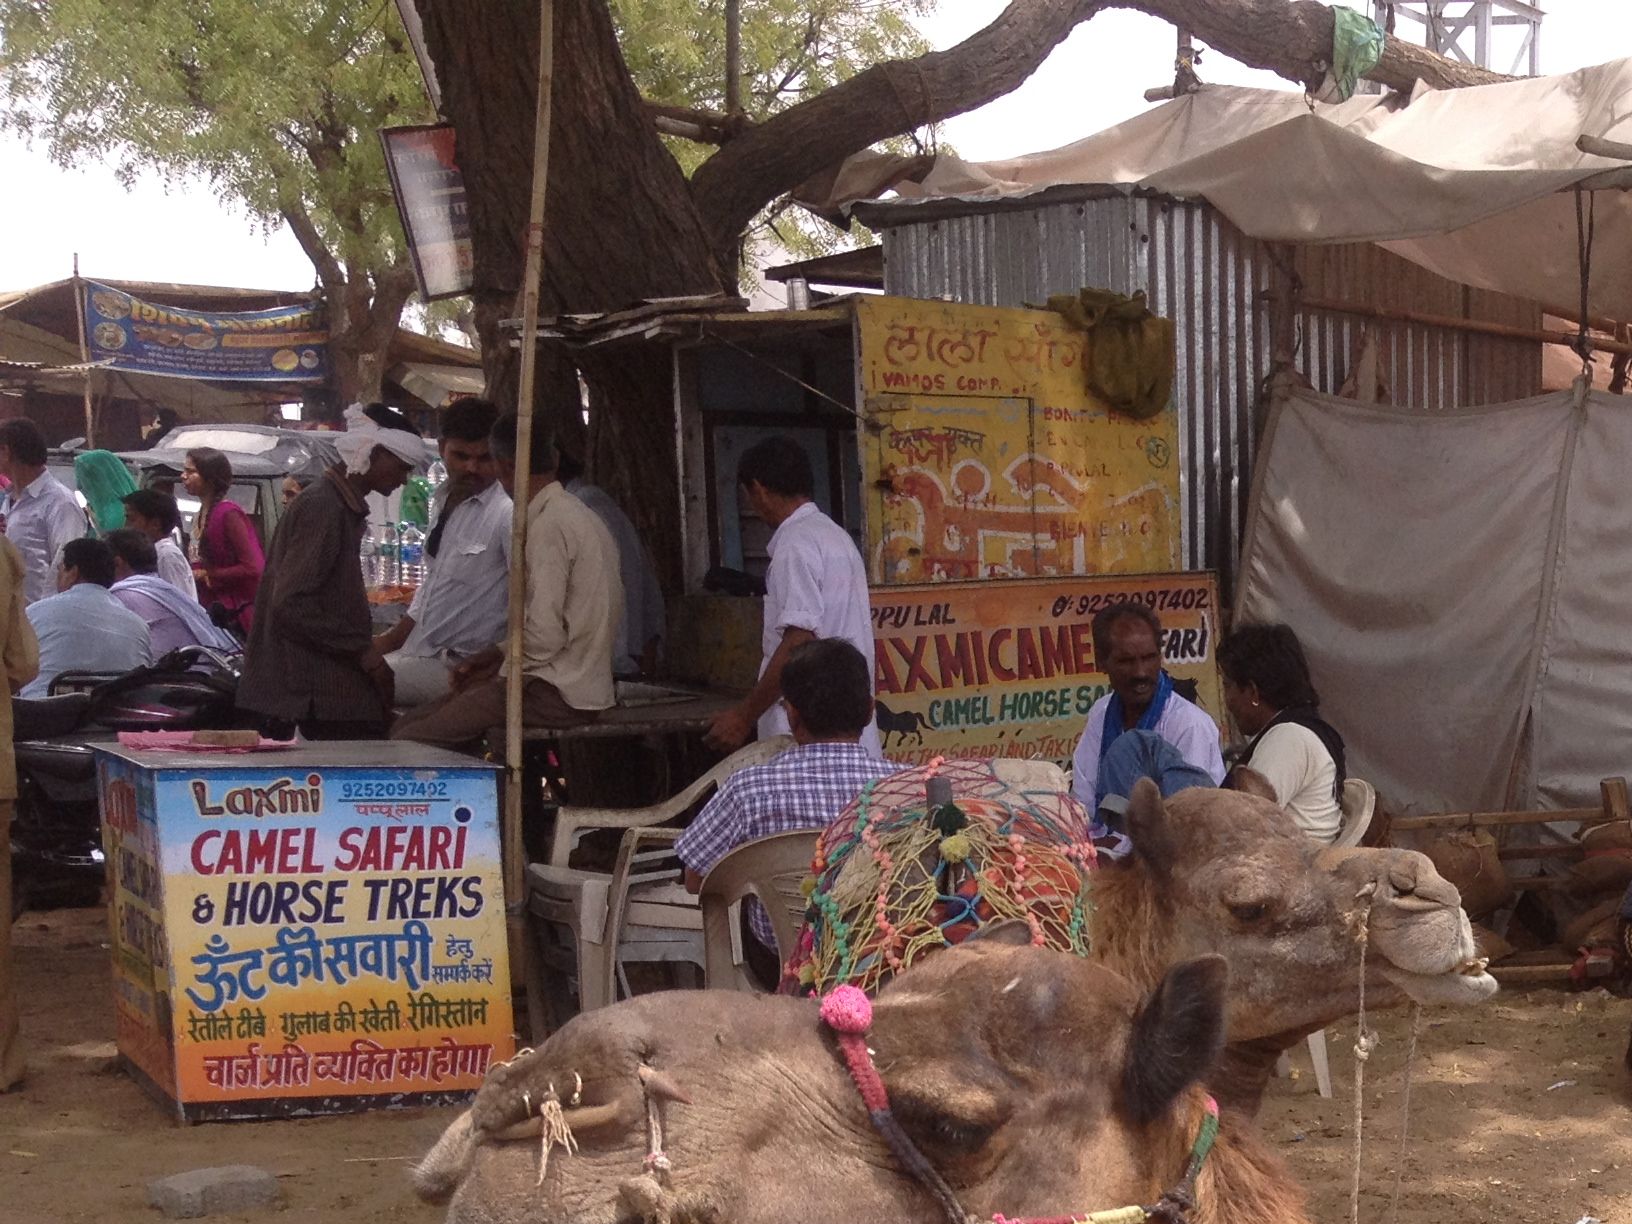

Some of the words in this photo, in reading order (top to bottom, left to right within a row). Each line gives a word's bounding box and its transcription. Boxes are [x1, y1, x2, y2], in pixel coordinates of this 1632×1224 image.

[914, 603, 956, 626] LAL
[928, 696, 994, 729] CAMEL
[999, 688, 1072, 721] HORSE
[191, 774, 322, 817] Laxmi
[190, 827, 324, 875] CAMEL
[192, 893, 215, 924] &
[222, 879, 349, 926] HORSE
[363, 875, 484, 921] TREKS
[324, 920, 433, 990] सवारी
